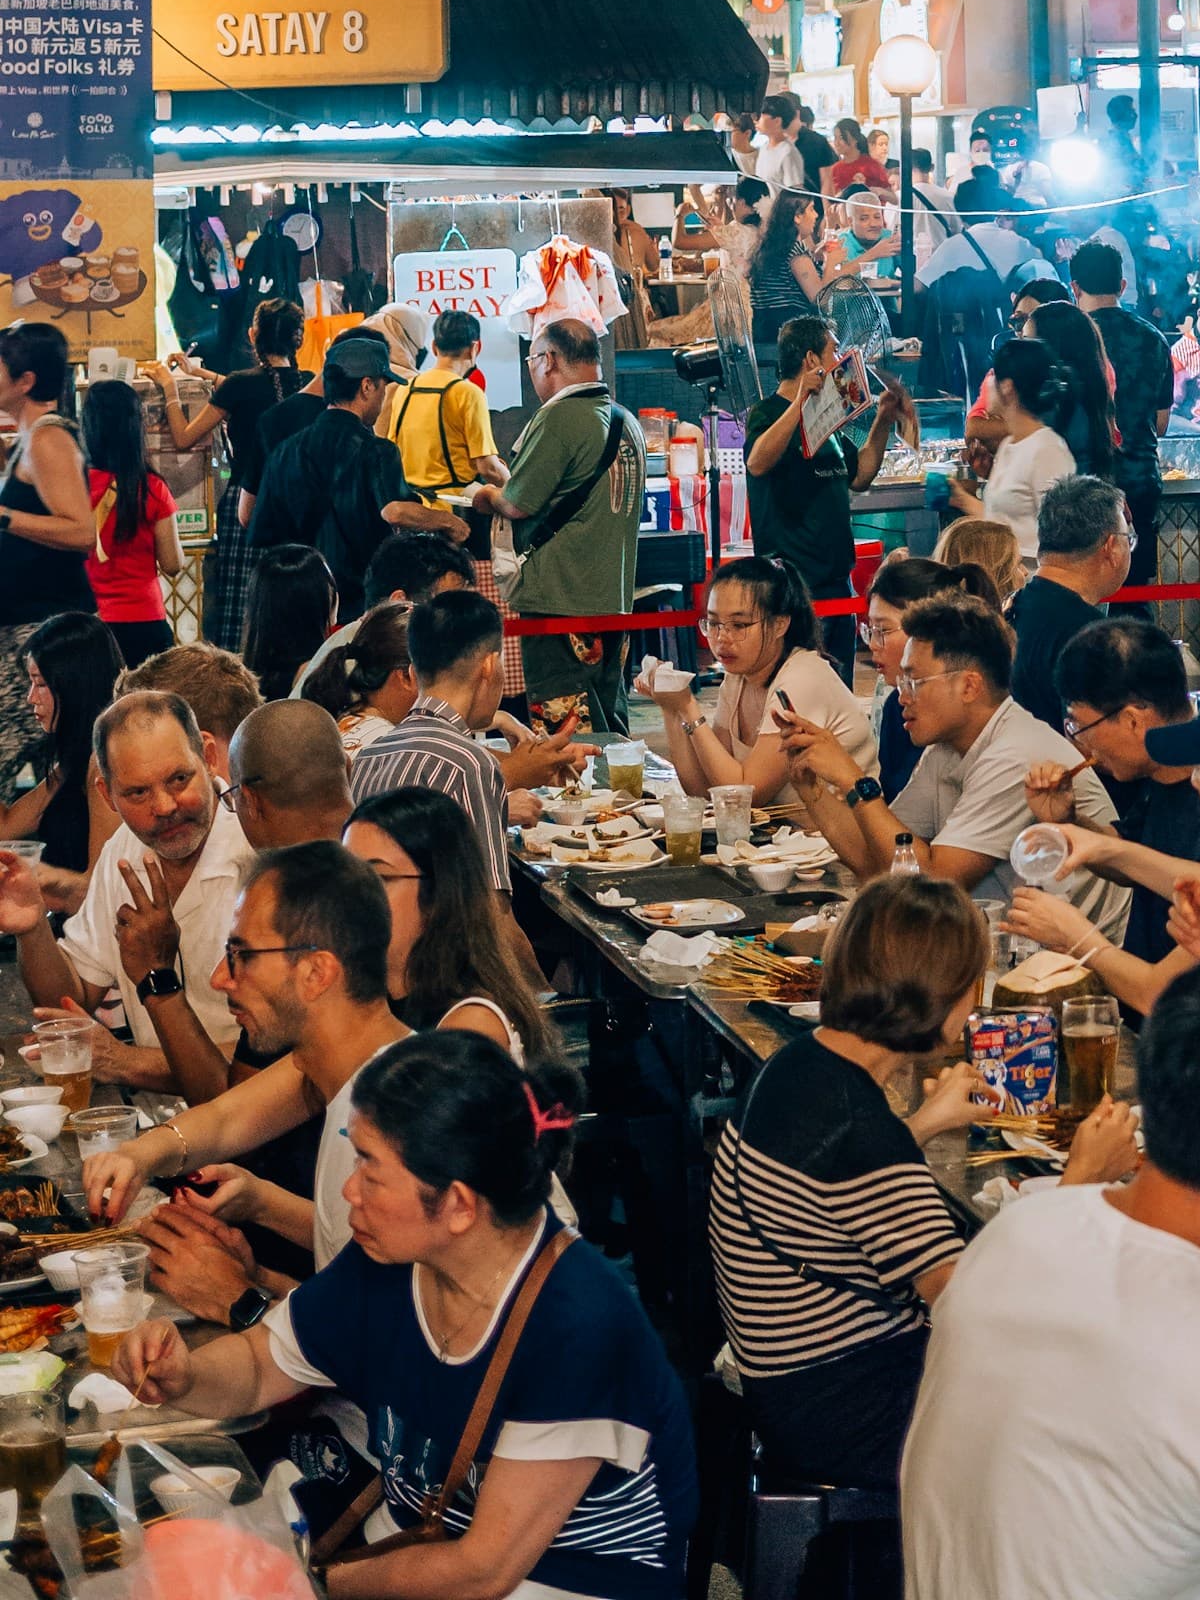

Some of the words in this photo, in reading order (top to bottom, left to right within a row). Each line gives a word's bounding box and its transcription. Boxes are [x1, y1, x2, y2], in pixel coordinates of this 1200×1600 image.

[0, 16, 80, 36] 中国大陆
[83, 18, 123, 35] Visa
[126, 17, 144, 36] 卡
[215, 11, 328, 57] SATAY
[342, 10, 366, 53] 8
[6, 38, 28, 55] 10
[31, 38, 87, 56] 新元返
[90, 39, 102, 55] 5
[104, 38, 142, 56] 新元
[0, 58, 40, 75] ood
[44, 58, 94, 75] Folks
[98, 58, 136, 77] 礼券
[80, 113, 113, 125] FOOD
[79, 124, 115, 135] FOLKS
[416, 266, 497, 293] BEST
[1008, 1063, 1052, 1090] Tiger
